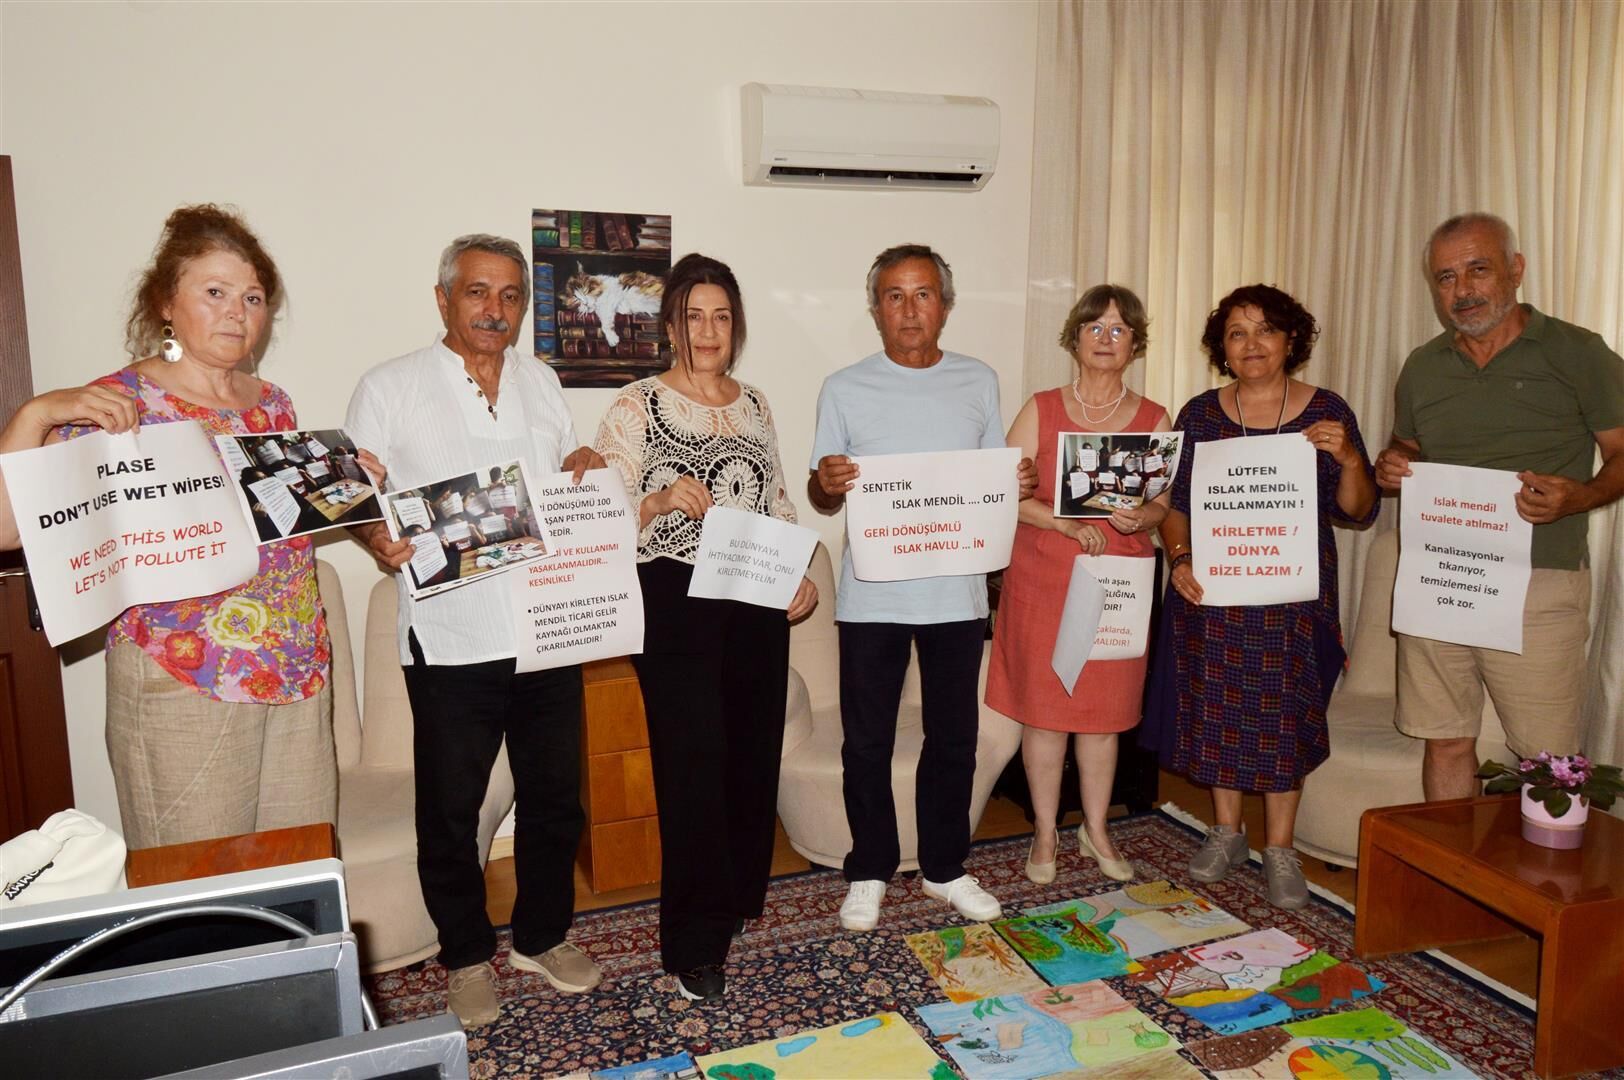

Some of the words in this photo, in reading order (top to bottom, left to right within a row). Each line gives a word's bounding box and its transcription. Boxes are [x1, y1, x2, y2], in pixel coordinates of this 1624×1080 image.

[97, 458, 155, 479] PLASE
[1228, 466, 1277, 476] LÜTFEN
[542, 488, 564, 496] ISLAK
[862, 479, 912, 493] SENTETİK
[1208, 485, 1245, 494] ISLAK
[1249, 481, 1299, 493] MENDİL
[93, 490, 118, 511] USE
[124, 485, 167, 501] WET
[597, 498, 611, 506] 100
[893, 499, 921, 509] ISLAK
[924, 495, 965, 506] MENDİL
[983, 494, 1005, 503] OUT
[1434, 497, 1457, 508] Islak
[1460, 500, 1496, 512] mendil
[1204, 500, 1296, 511] KULLANMAYIN
[566, 512, 595, 522] PETROL
[597, 509, 625, 520] TÜREVİ
[1421, 512, 1462, 526] tuvalete
[864, 525, 889, 538] GERİ
[892, 521, 961, 536] DÖNÜŞÜMLÜ
[1212, 525, 1287, 537] KİRLETME
[69, 551, 90, 571] WE
[94, 539, 117, 561] NEED
[173, 521, 223, 541] WORLD
[563, 548, 574, 556] VE
[575, 543, 619, 555] KULLANIMI
[730, 539, 740, 547] BU
[894, 544, 922, 554] ISLAK
[925, 540, 958, 552] HAVLU
[974, 538, 984, 548] İN
[1228, 544, 1280, 556] DÜNYA
[1424, 543, 1504, 563] Kanalizasyonlar
[108, 557, 128, 578] NOT
[135, 546, 205, 567] POLLUTE
[774, 564, 795, 575] ONU
[1209, 564, 1241, 576] BİZE
[1246, 566, 1291, 576] LAZIM
[528, 574, 575, 587] KESİNLİKLE!
[1420, 575, 1481, 593] temizlemesi
[1483, 584, 1499, 596] ise
[533, 601, 568, 614] DÜNYAYI
[570, 595, 606, 608] KİRLETEN
[608, 592, 629, 602] ISLAK
[1437, 595, 1455, 606] çok
[1457, 599, 1475, 609] zor.
[535, 614, 566, 627] MENDİL
[595, 606, 617, 617] GELİR
[536, 625, 571, 640] KAYNAĞI
[573, 620, 617, 634] OLMAKTAN
